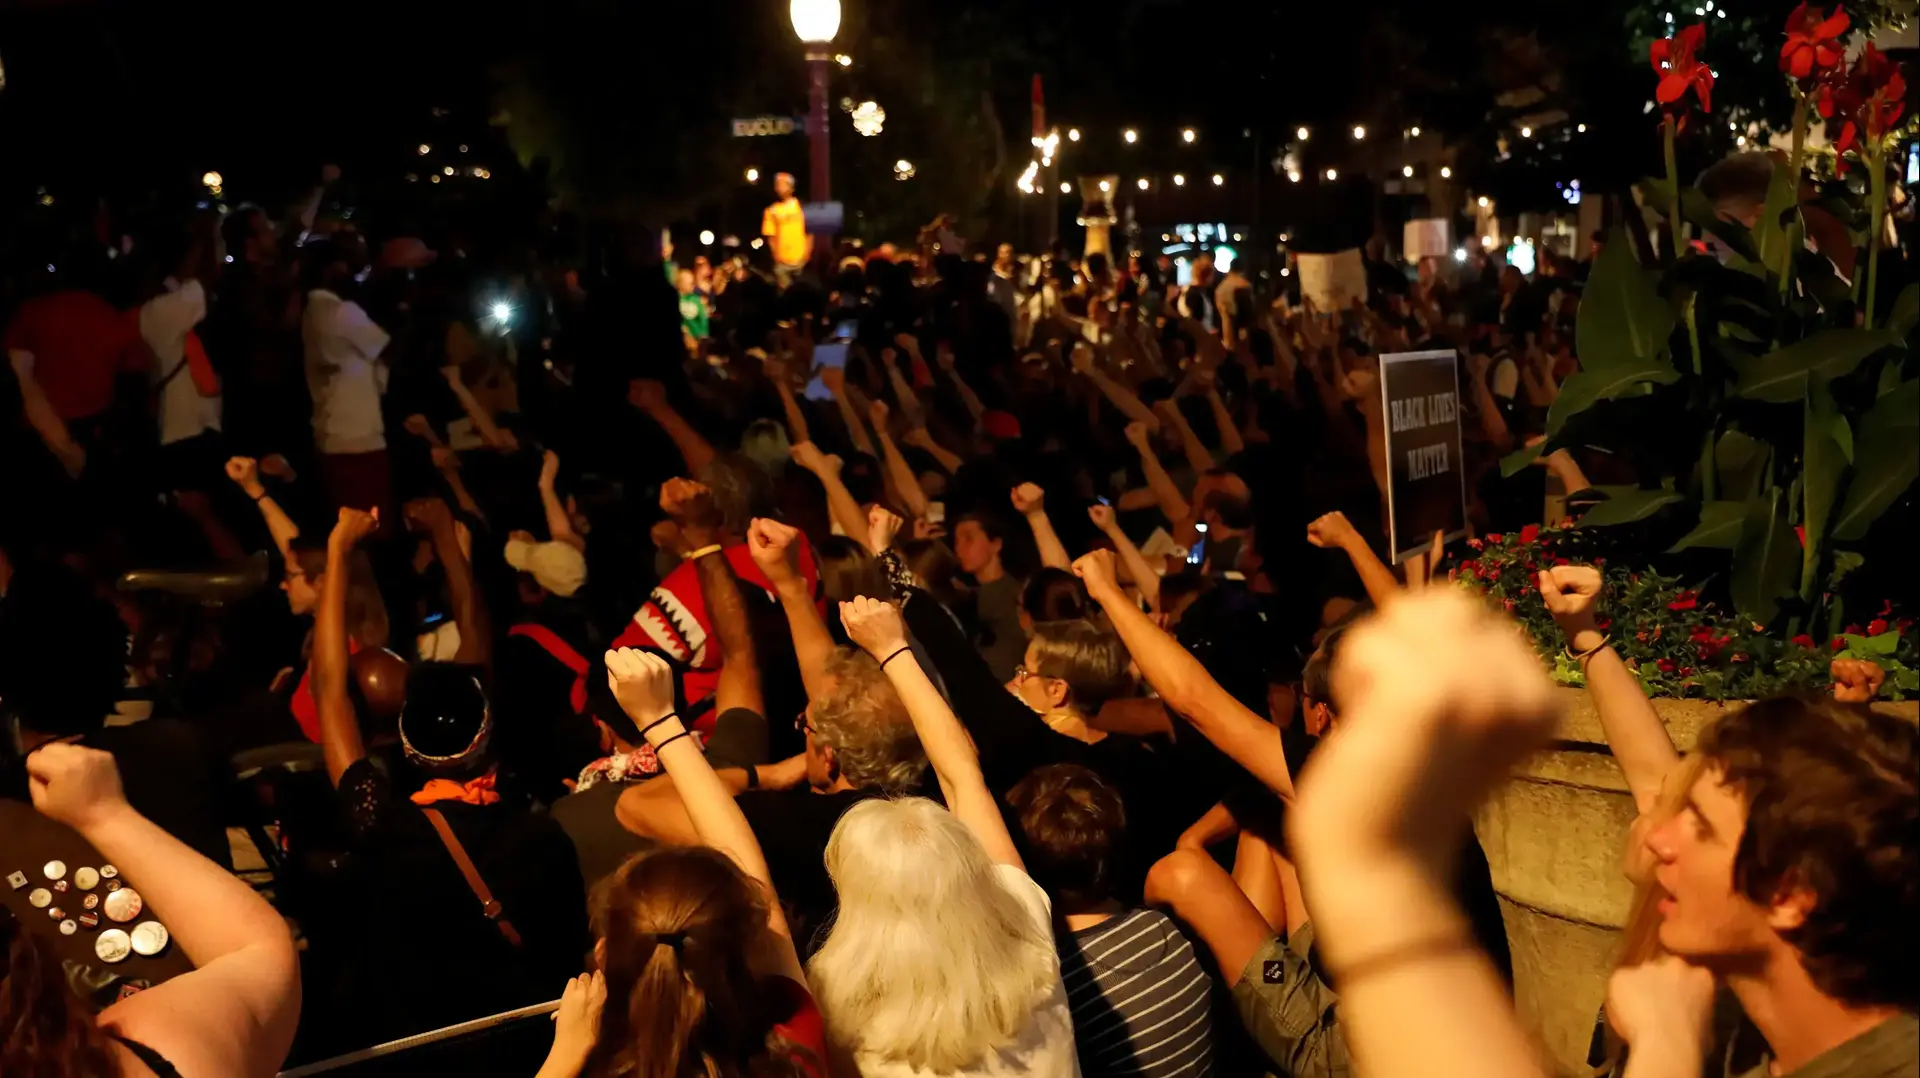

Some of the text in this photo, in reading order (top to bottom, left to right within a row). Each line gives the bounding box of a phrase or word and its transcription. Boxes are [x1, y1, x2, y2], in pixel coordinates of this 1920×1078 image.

[1391, 392, 1456, 433] BLACK LIVES
[1407, 442, 1449, 482] MATTER
